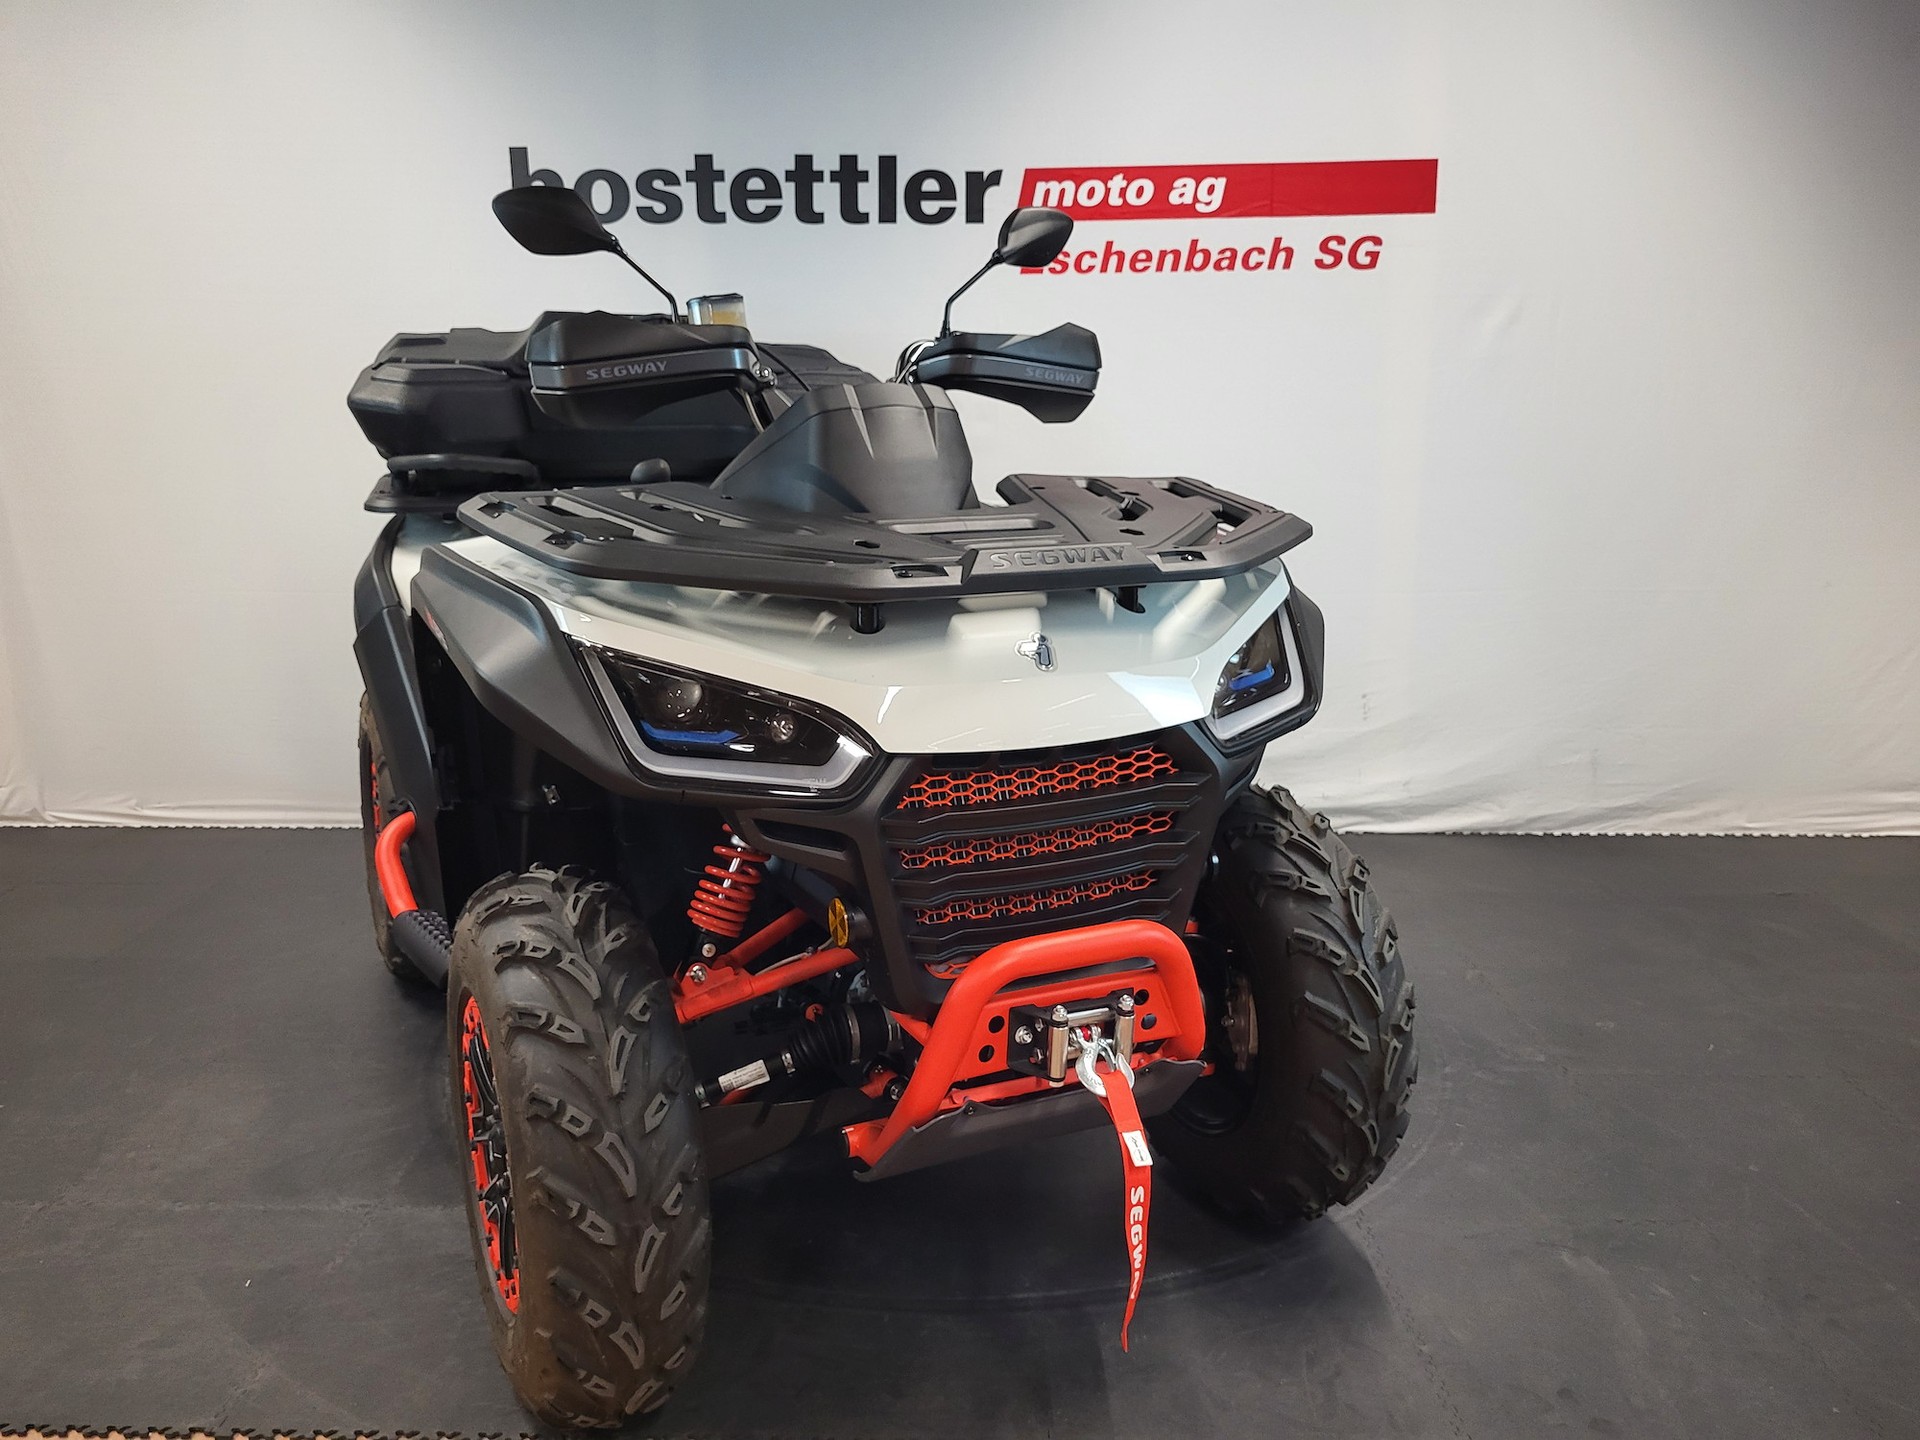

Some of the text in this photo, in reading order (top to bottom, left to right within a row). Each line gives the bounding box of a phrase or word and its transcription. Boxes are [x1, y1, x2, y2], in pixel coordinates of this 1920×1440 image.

[1032, 173, 1228, 213] moto ag
[1020, 235, 1384, 275] schenbach SG
[586, 361, 668, 380] SEGWAY
[1025, 367, 1084, 384] SEGWAY
[990, 546, 1126, 570] SEGWAY
[1130, 1185, 1145, 1299] SEGW
